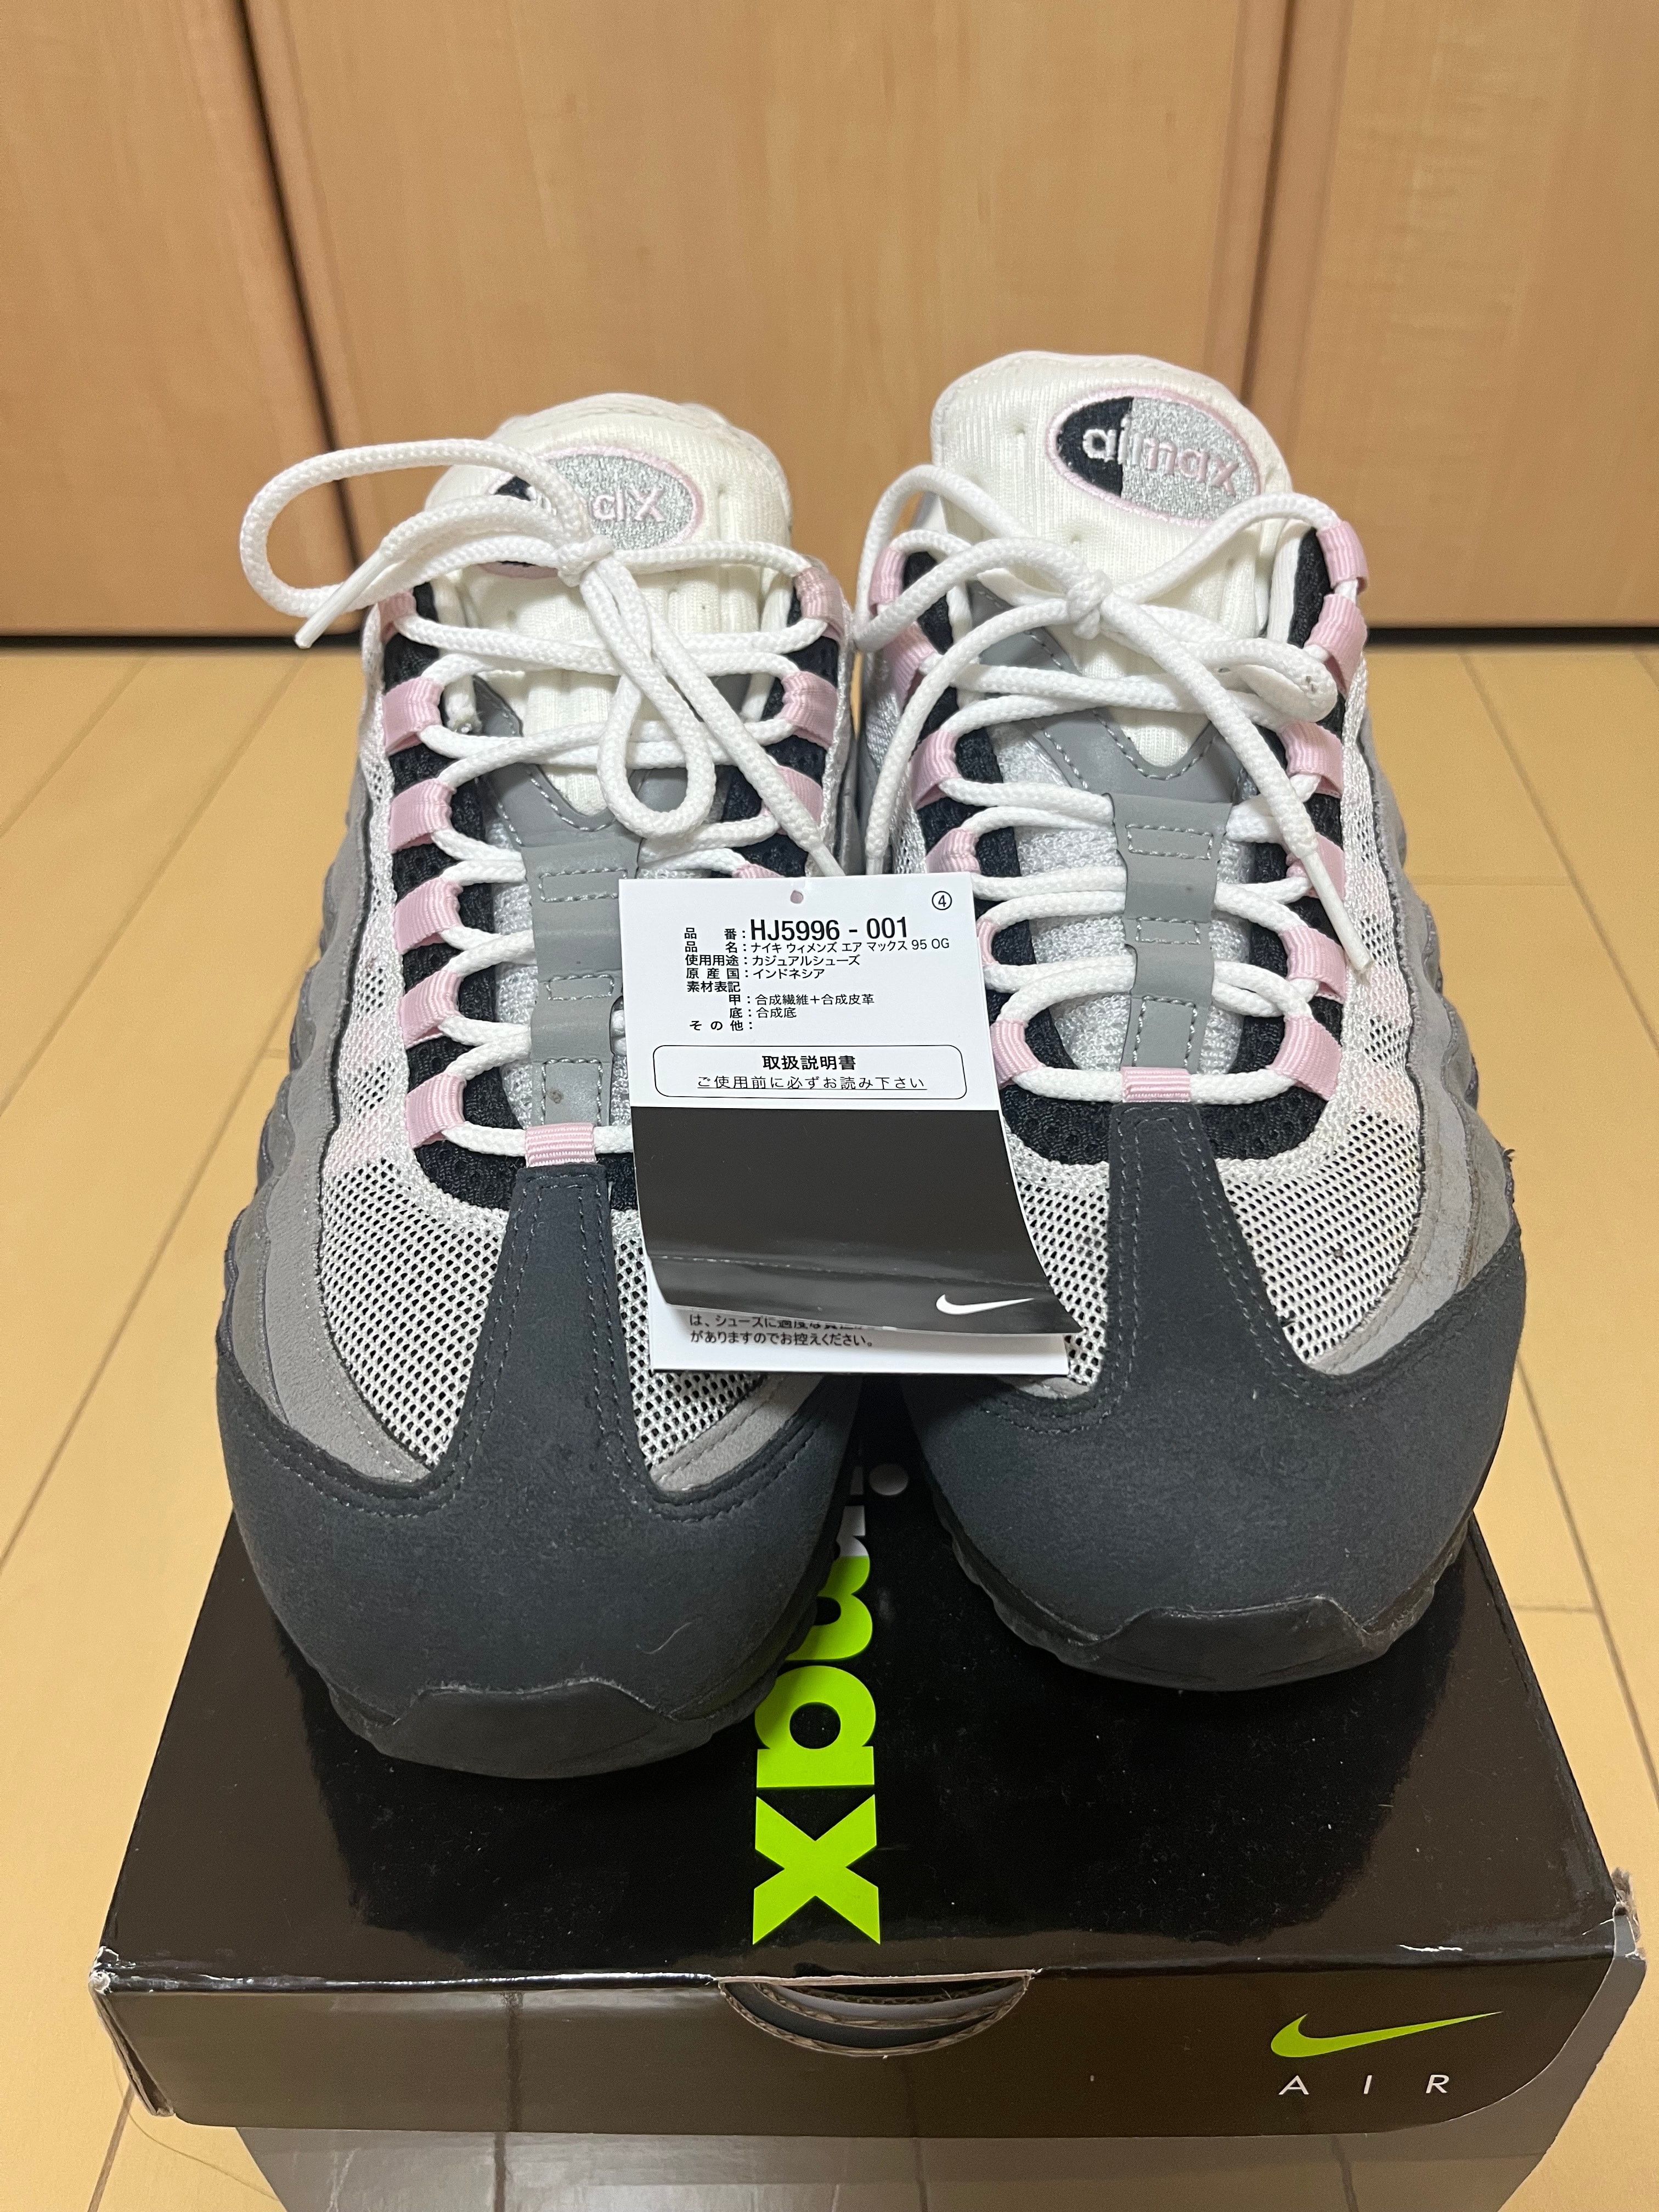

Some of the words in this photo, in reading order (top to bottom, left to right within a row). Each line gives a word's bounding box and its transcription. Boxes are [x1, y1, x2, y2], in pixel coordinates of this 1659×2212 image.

[751, 918, 840, 941] HJ5996
[866, 916, 907, 939] 001
[842, 941, 862, 952] エア
[911, 939, 928, 951] 95
[932, 938, 950, 950] OG
[686, 980, 741, 993] 素材表記
[761, 1055, 856, 1070] 取扱説明書
[697, 1075, 926, 1090] ご使用前に必ずお読み下さい
[691, 1330, 873, 1348] がありますのでお控えください。
